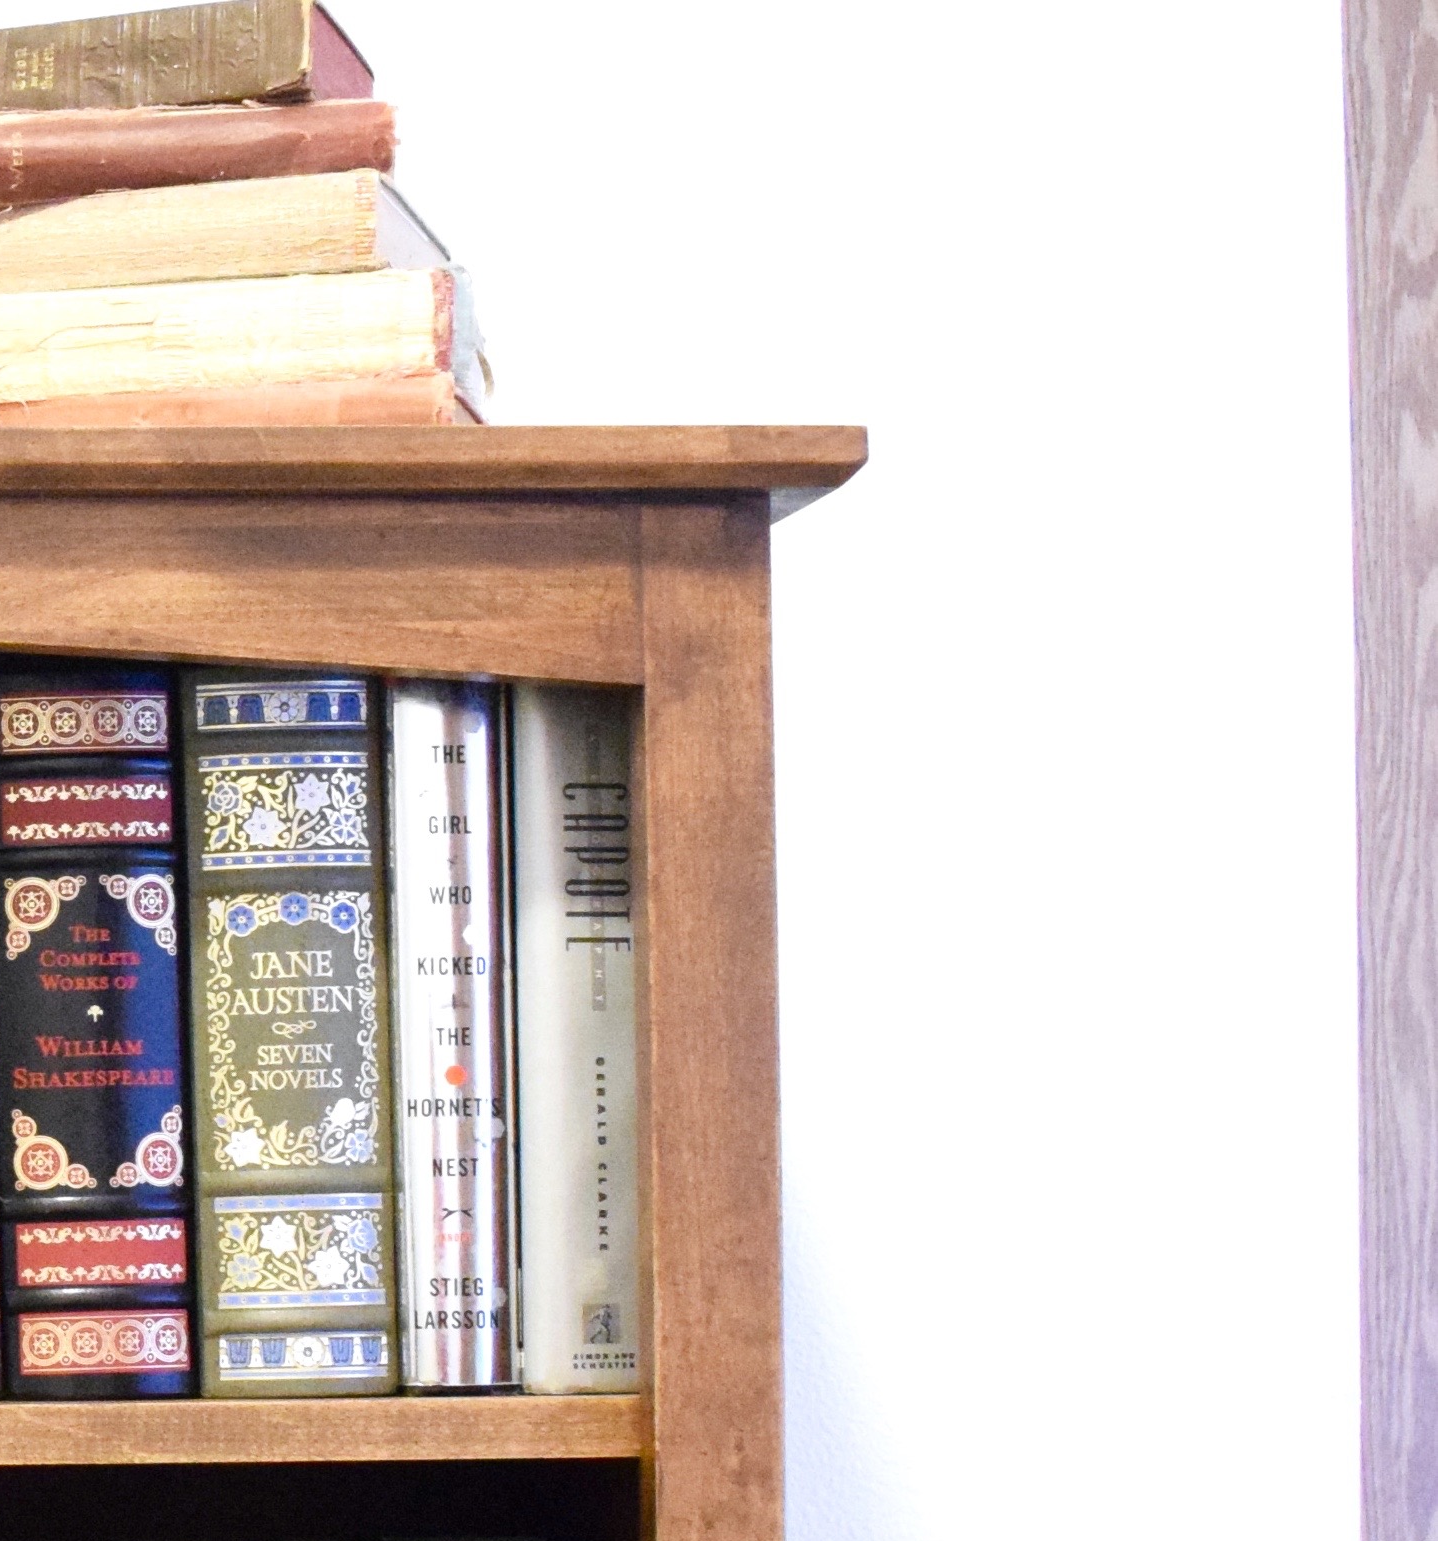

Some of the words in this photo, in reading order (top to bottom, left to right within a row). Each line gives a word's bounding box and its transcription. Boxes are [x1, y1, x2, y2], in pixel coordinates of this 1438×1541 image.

[250, 951, 334, 980] JANE
[230, 986, 354, 1016] AUSTEN
[257, 1045, 332, 1065] SEVEN
[250, 1068, 343, 1090] NOVELS
